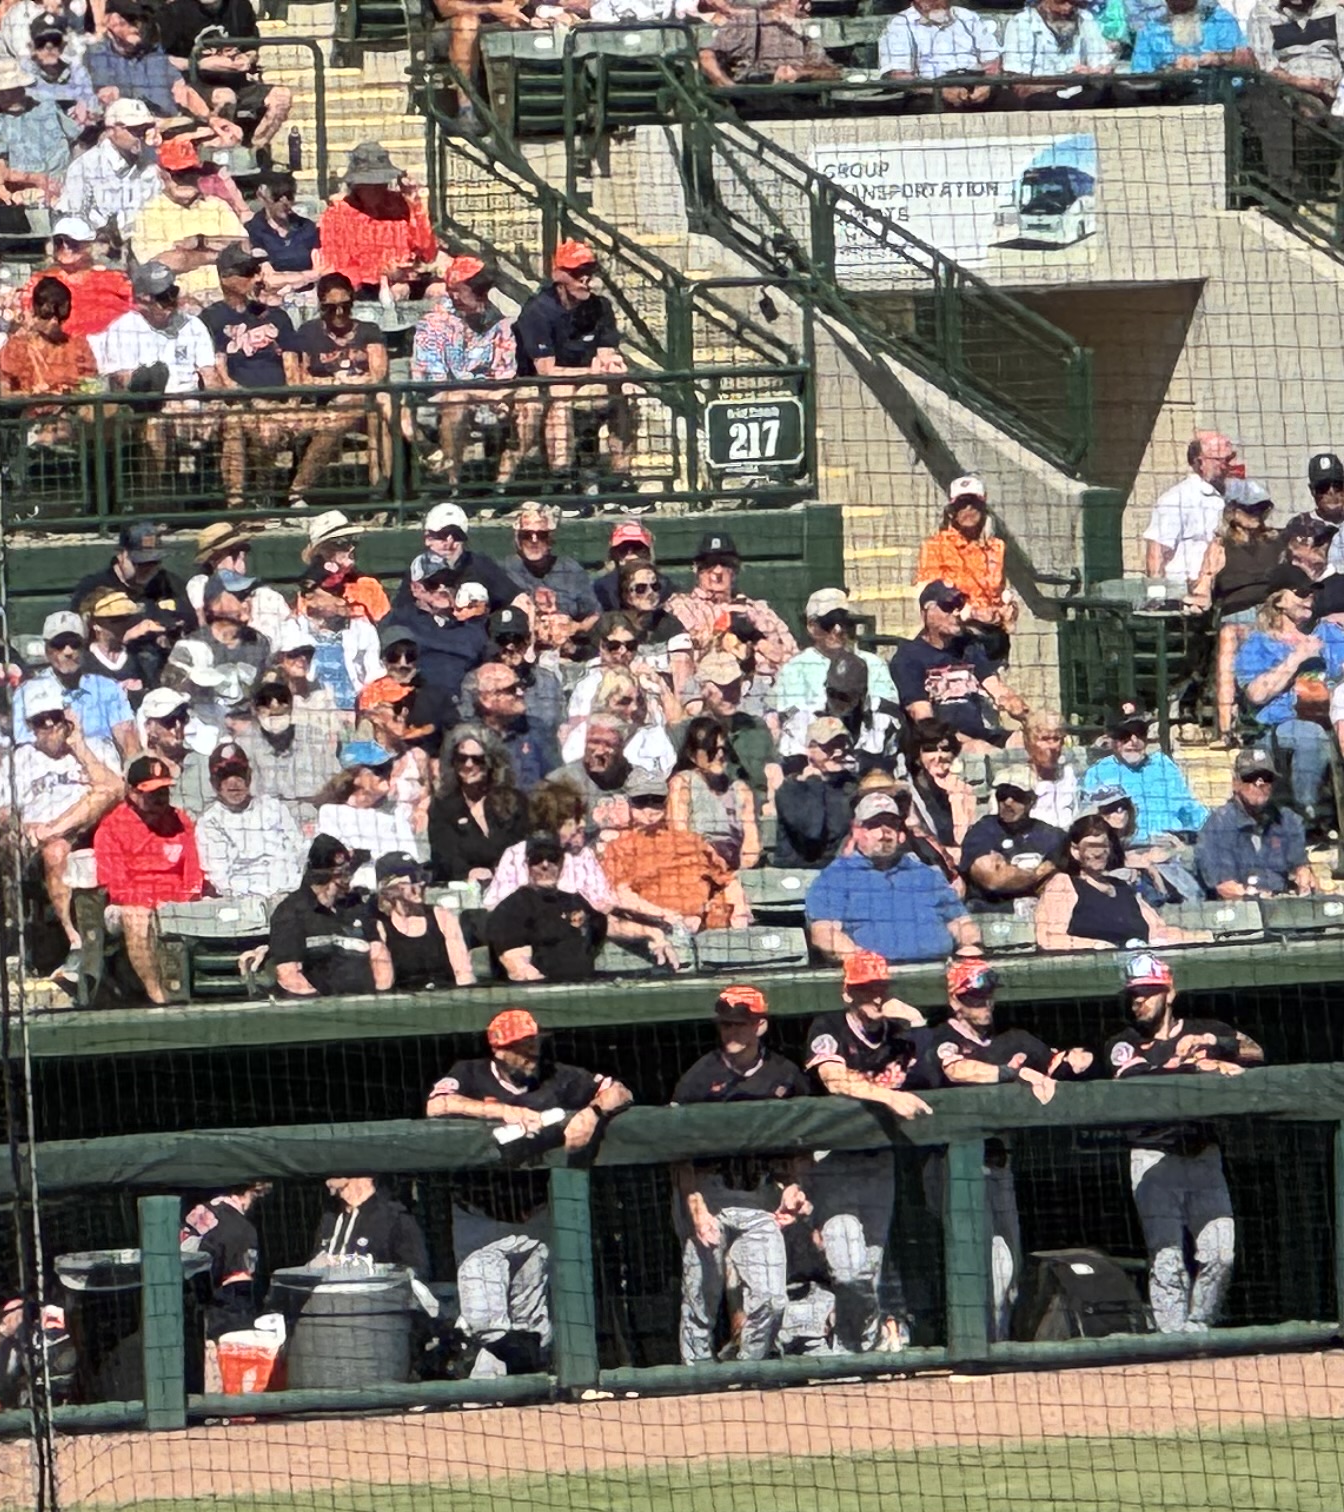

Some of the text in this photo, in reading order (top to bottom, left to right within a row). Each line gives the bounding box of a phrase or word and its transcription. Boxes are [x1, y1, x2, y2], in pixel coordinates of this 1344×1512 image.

[822, 161, 890, 179] GROUP
[844, 180, 1000, 200] ANSPORTATION
[729, 420, 780, 460] 217
